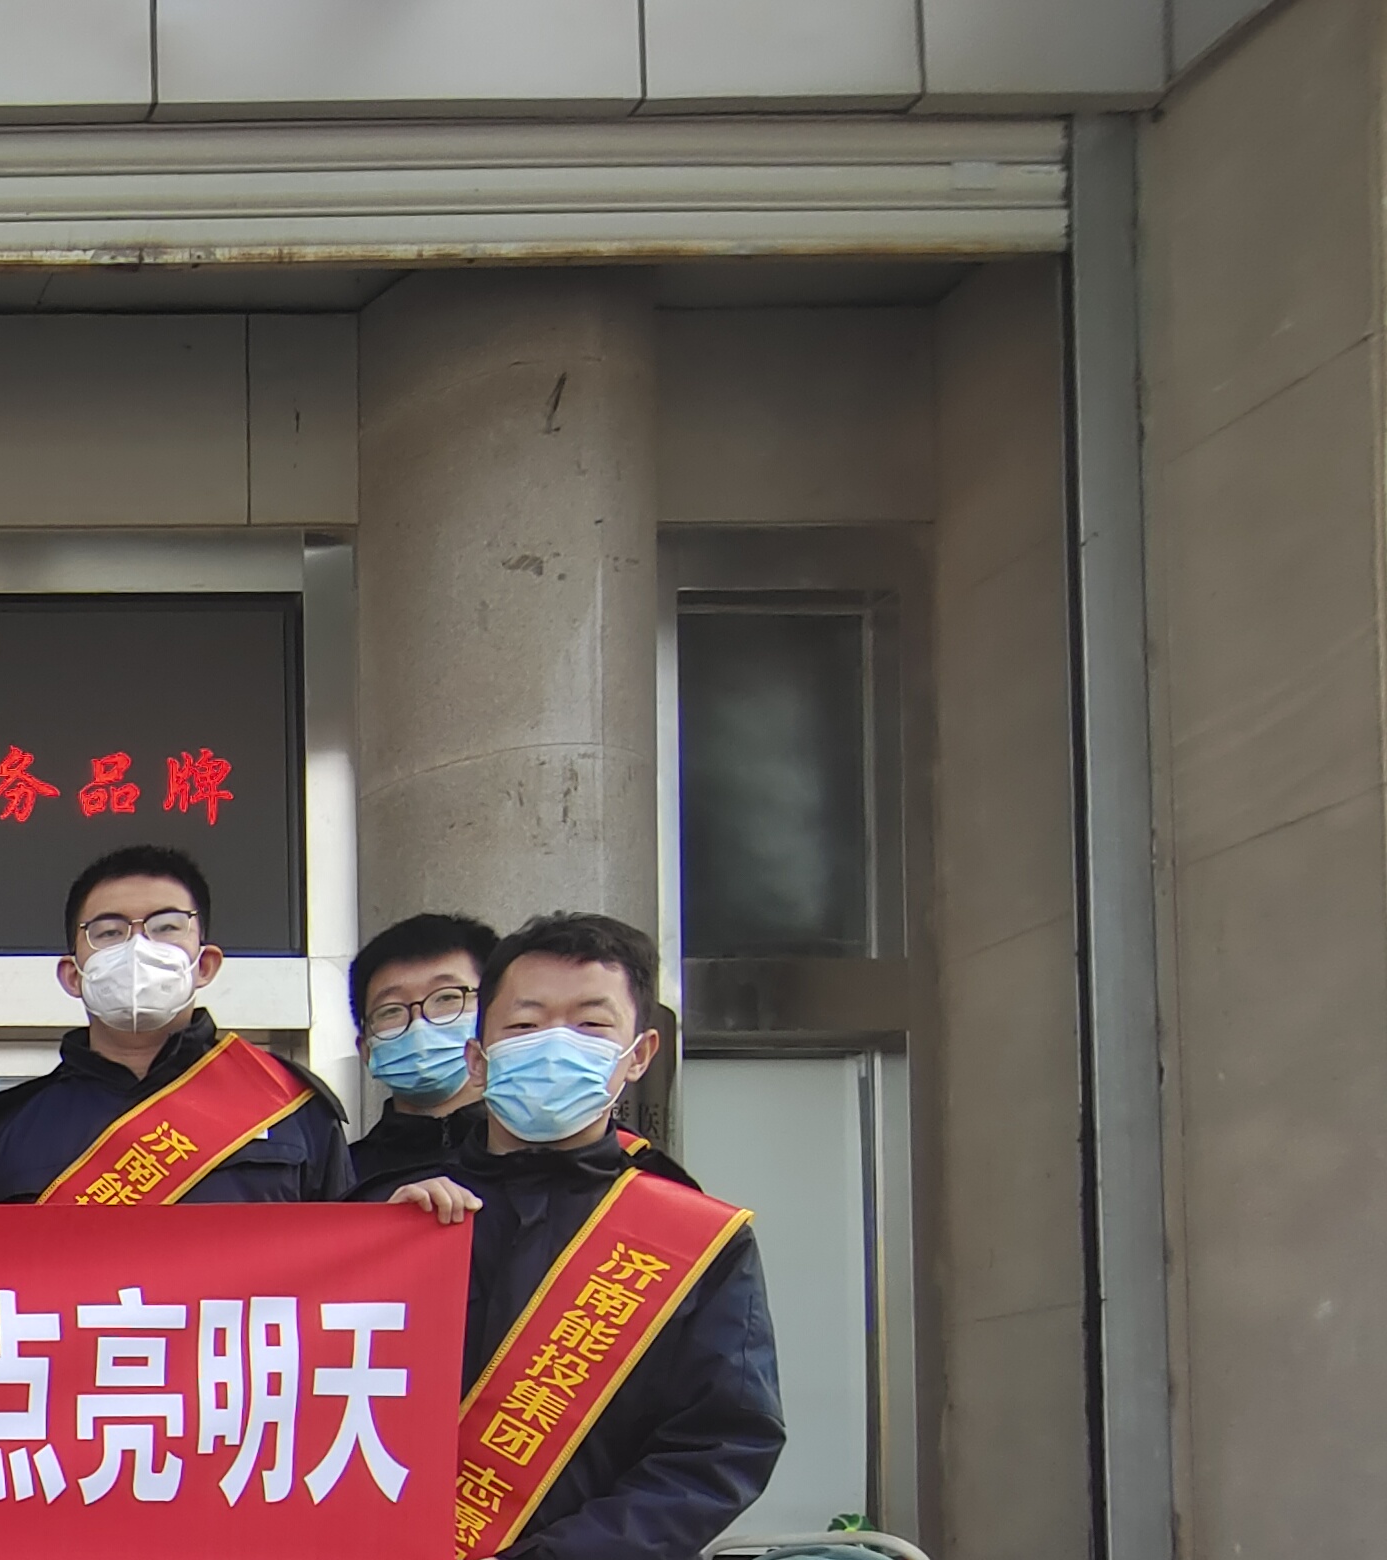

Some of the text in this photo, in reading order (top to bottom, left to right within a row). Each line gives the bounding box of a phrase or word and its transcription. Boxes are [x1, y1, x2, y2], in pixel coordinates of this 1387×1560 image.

[75, 1121, 199, 1205] 济南能
[480, 1241, 671, 1467] 济南能投集团
